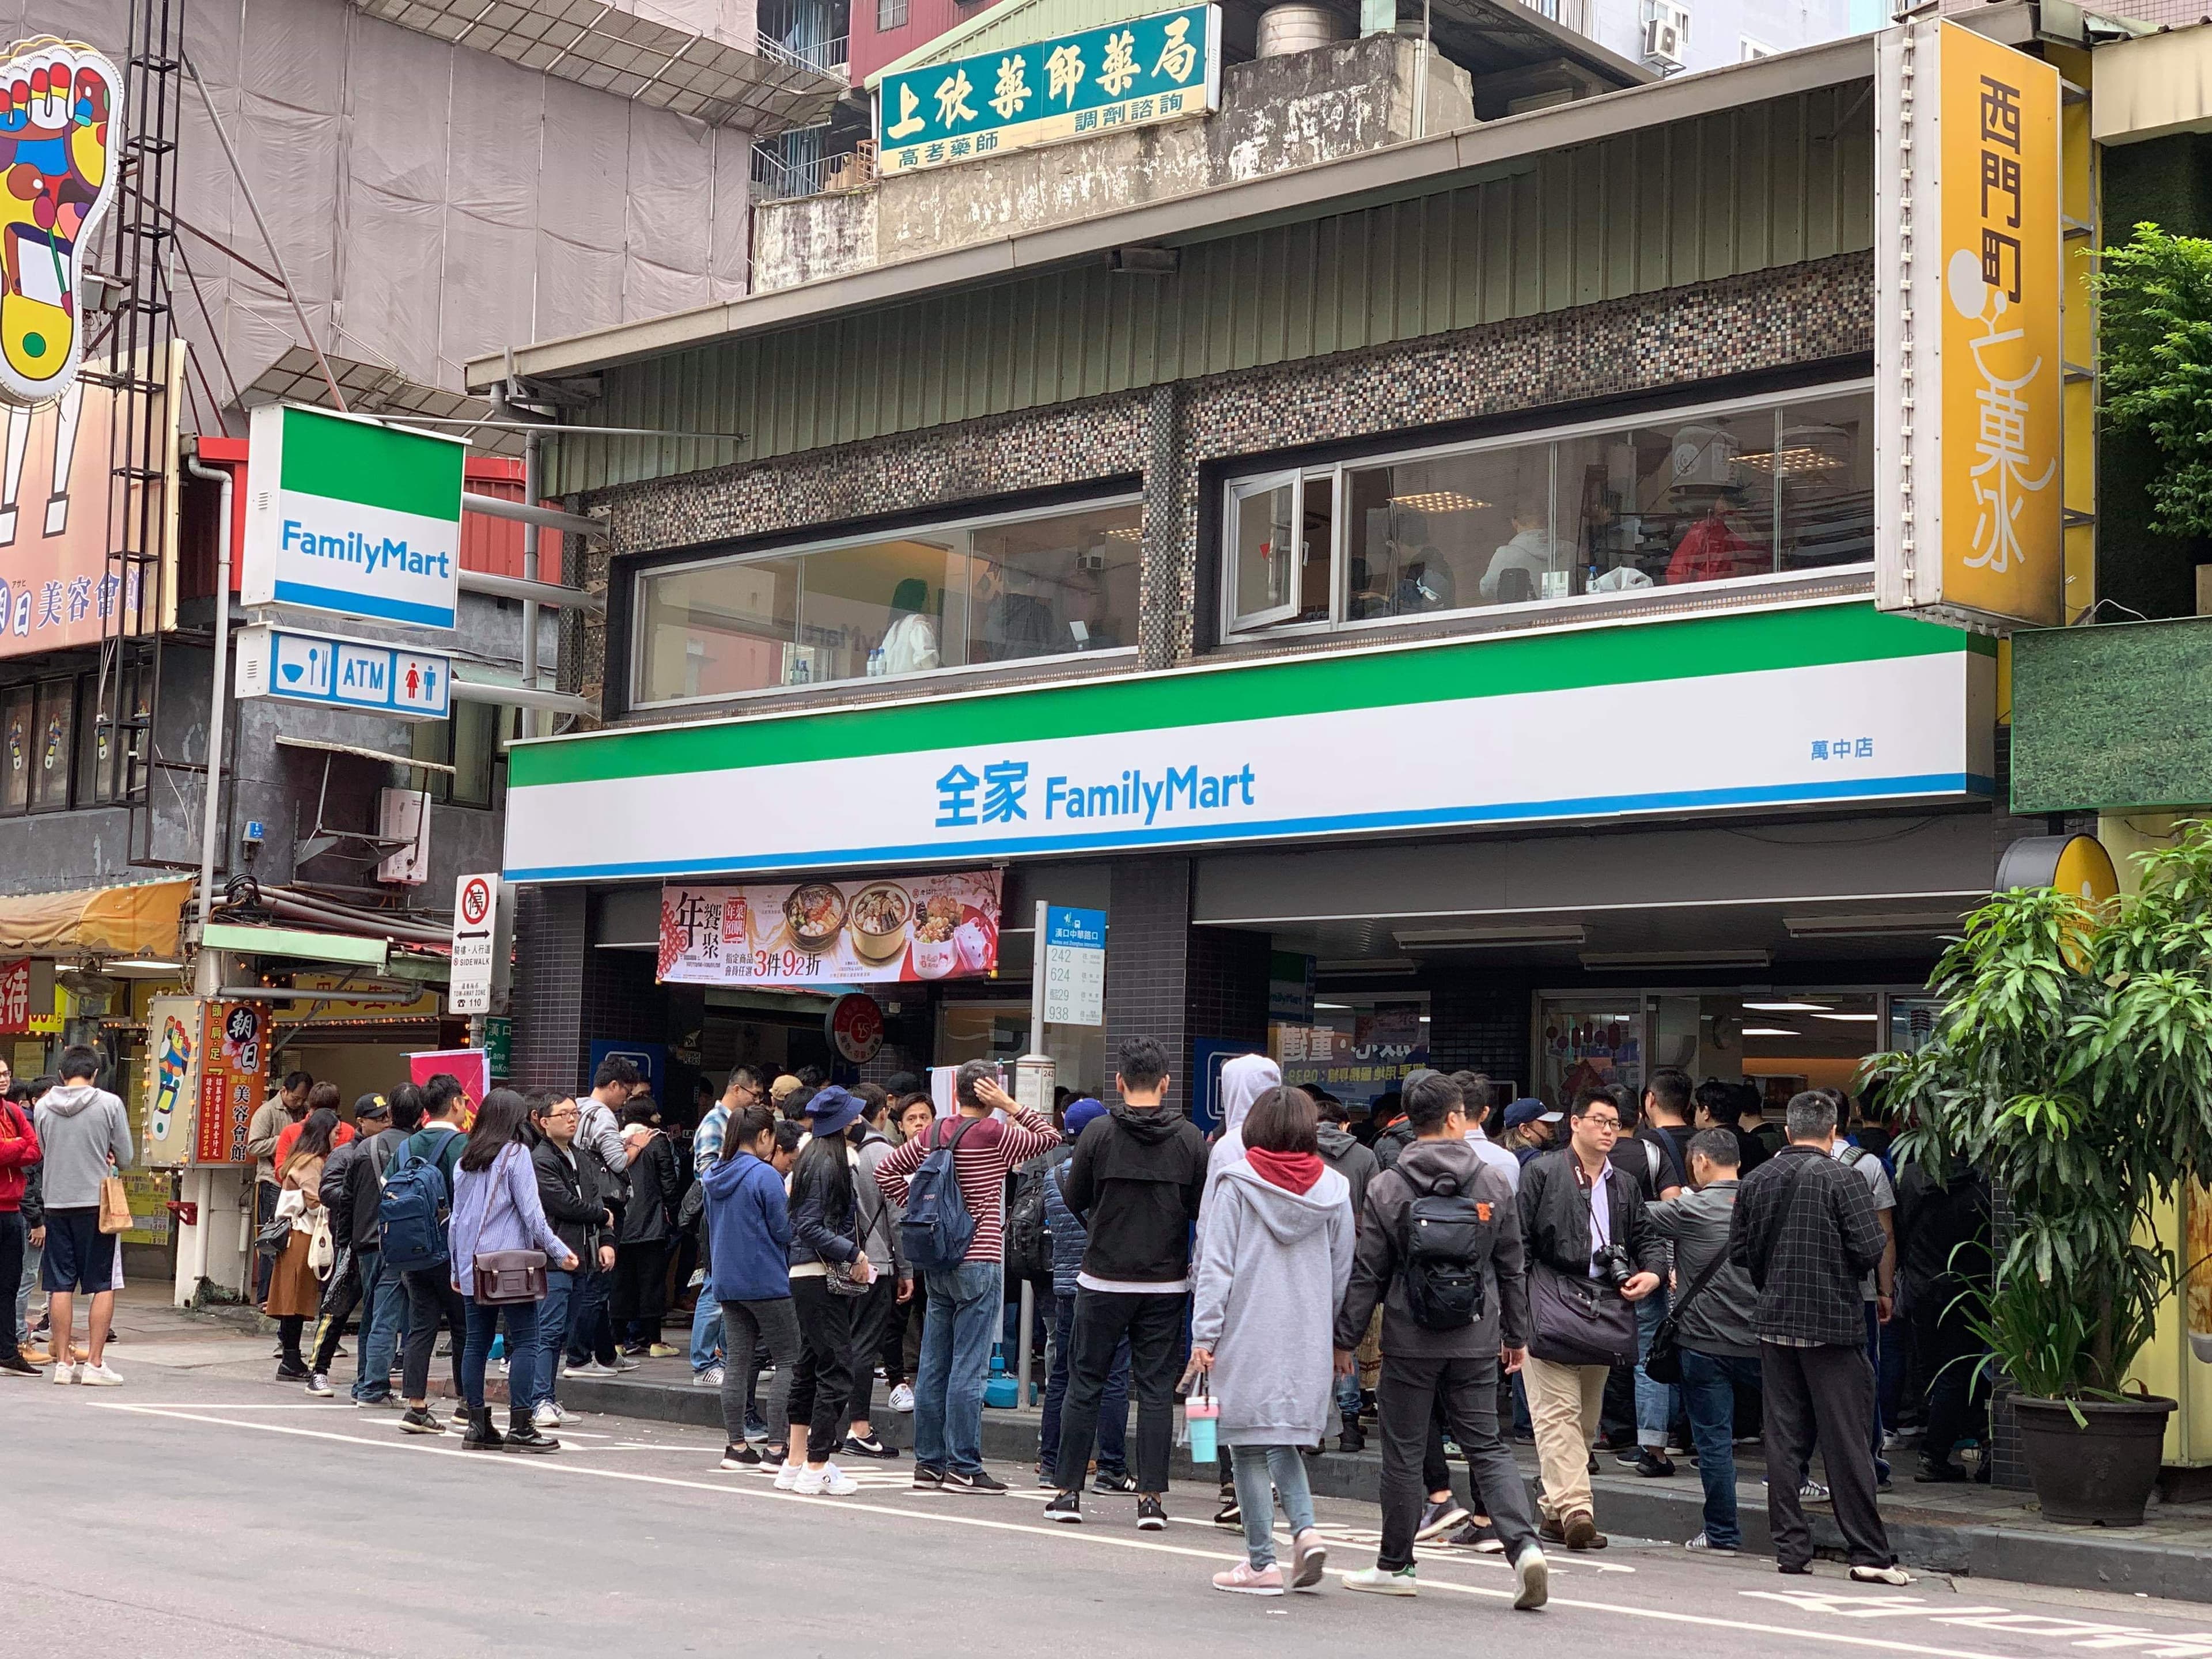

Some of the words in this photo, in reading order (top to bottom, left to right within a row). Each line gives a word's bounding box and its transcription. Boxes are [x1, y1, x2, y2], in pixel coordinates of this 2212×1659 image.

[1075, 93, 1183, 132] 調劑諮詢
[898, 130, 998, 168] 高考藥師
[1980, 74, 2021, 304] 西門町
[282, 519, 450, 578] FamilyMart
[343, 658, 384, 690] ATM
[1811, 737, 1873, 760] 萬中店
[935, 760, 1029, 827] 全家
[1046, 763, 1255, 825] FamilyMart
[468, 889, 483, 915] 停
[1055, 928, 1098, 940] 漢口中華路口
[460, 957, 490, 966] SIDEWALK
[726, 953, 753, 964] 指定商品
[1051, 948, 1071, 963] 242
[1051, 968, 1070, 982] 624
[469, 998, 481, 1006] 110
[1049, 1006, 1069, 1020] 938
[229, 1009, 259, 1069] 朝日
[488, 1023, 511, 1036] 漢口
[489, 1051, 505, 1060] Lane
[230, 1085, 251, 1162] 美容會館
